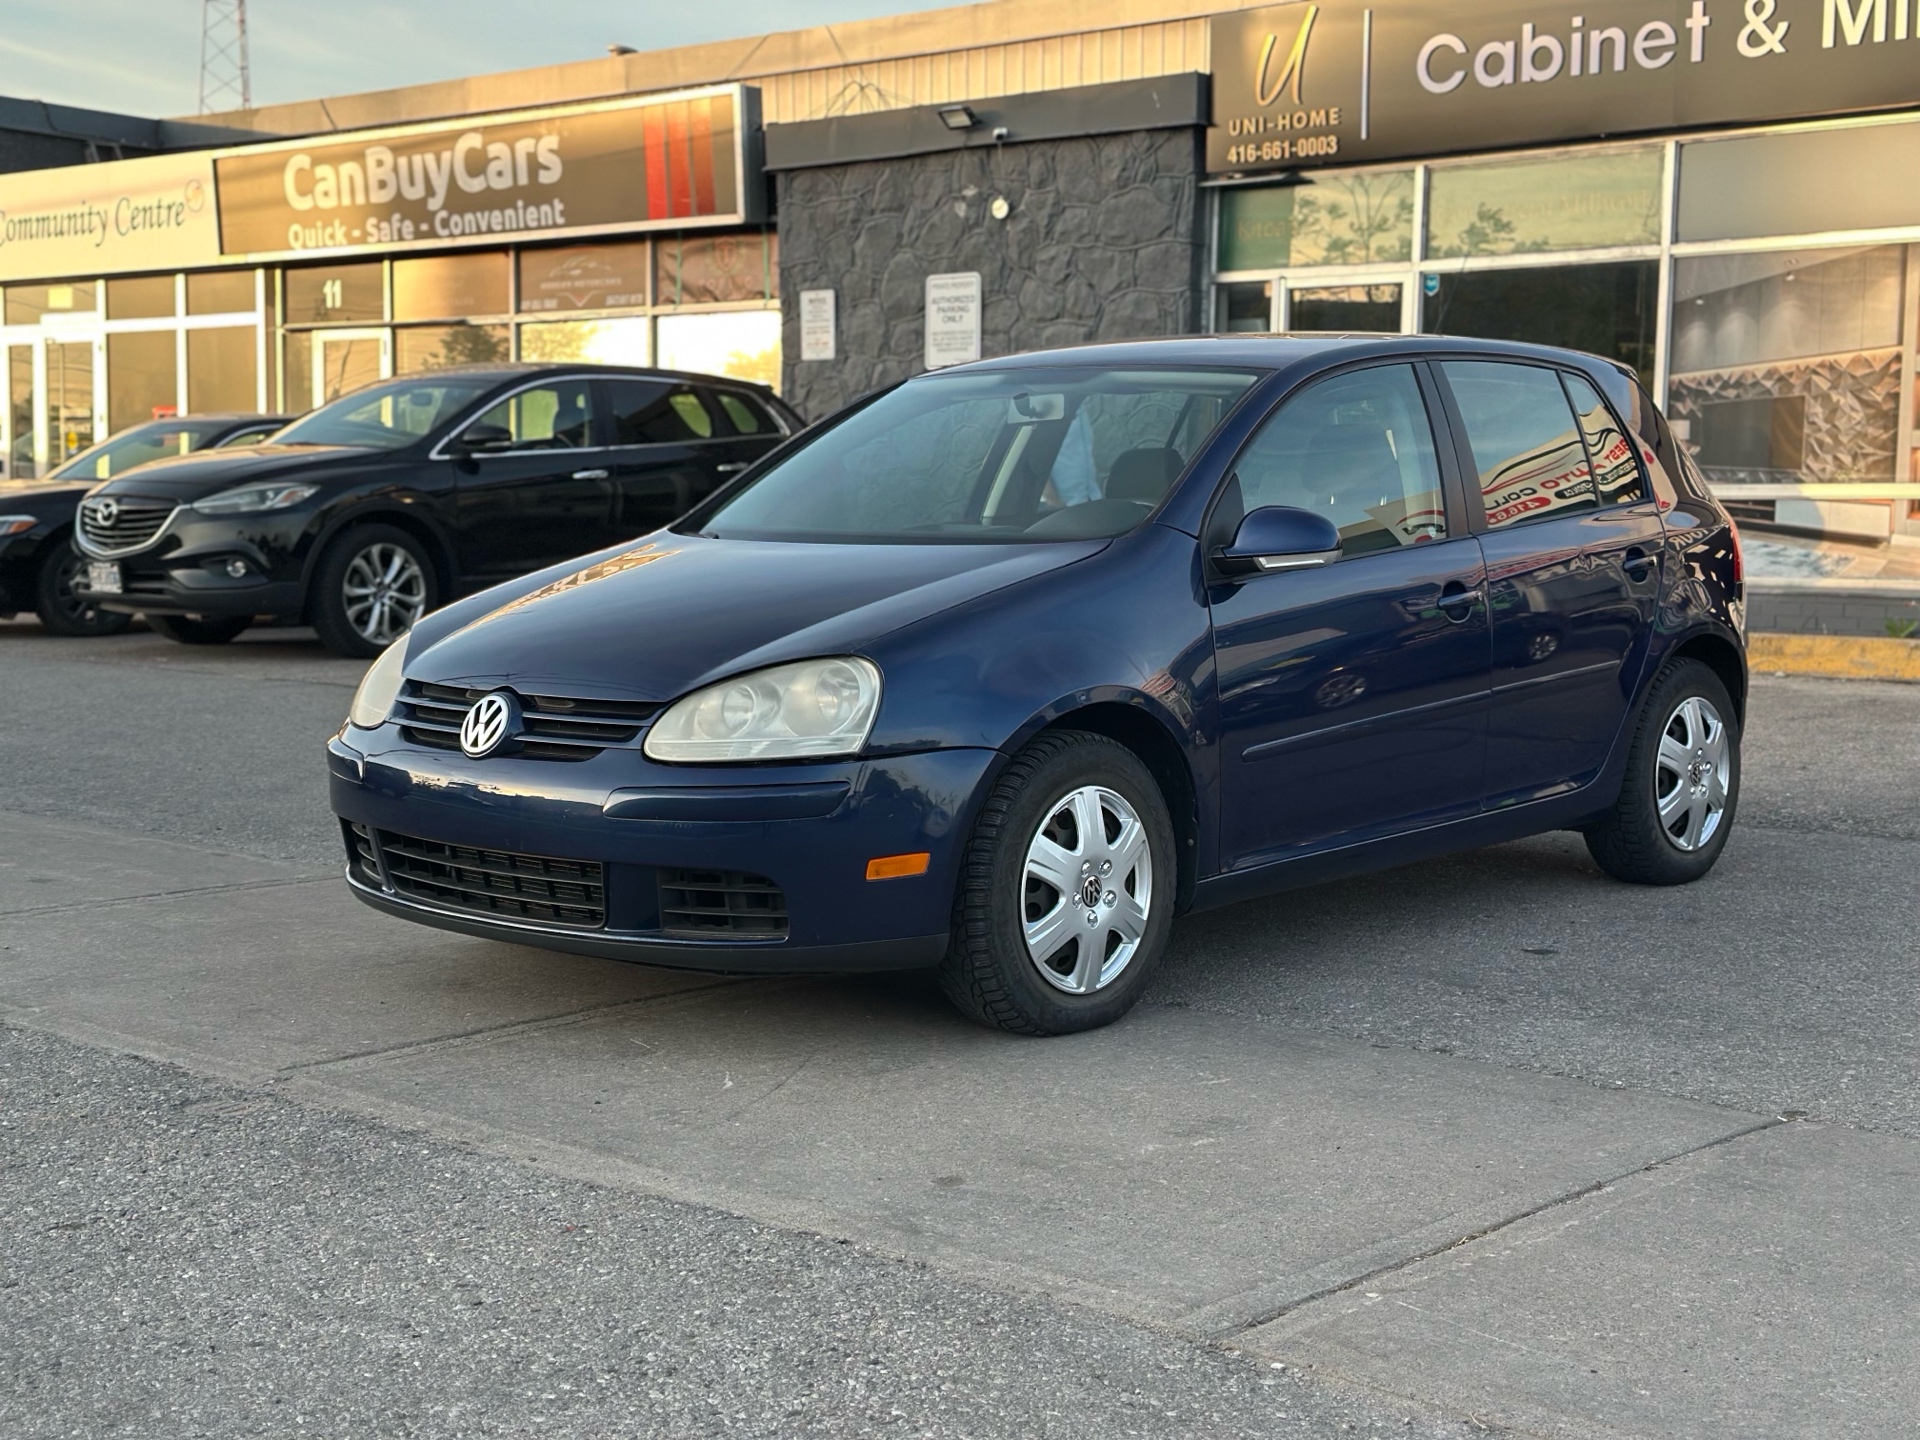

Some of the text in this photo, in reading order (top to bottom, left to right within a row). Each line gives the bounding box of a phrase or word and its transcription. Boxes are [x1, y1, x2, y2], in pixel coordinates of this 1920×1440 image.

[1416, 0, 1920, 94] Cabinet & Mi
[1228, 107, 1340, 136] UNI-HOME
[1227, 135, 1338, 164] 416-661-0003
[283, 132, 563, 211] CanBuyCars
[115, 197, 186, 236] Centre
[288, 219, 348, 250] Quick
[366, 212, 415, 244] Safe
[434, 198, 566, 237] Convenient
[322, 279, 342, 309] 11
